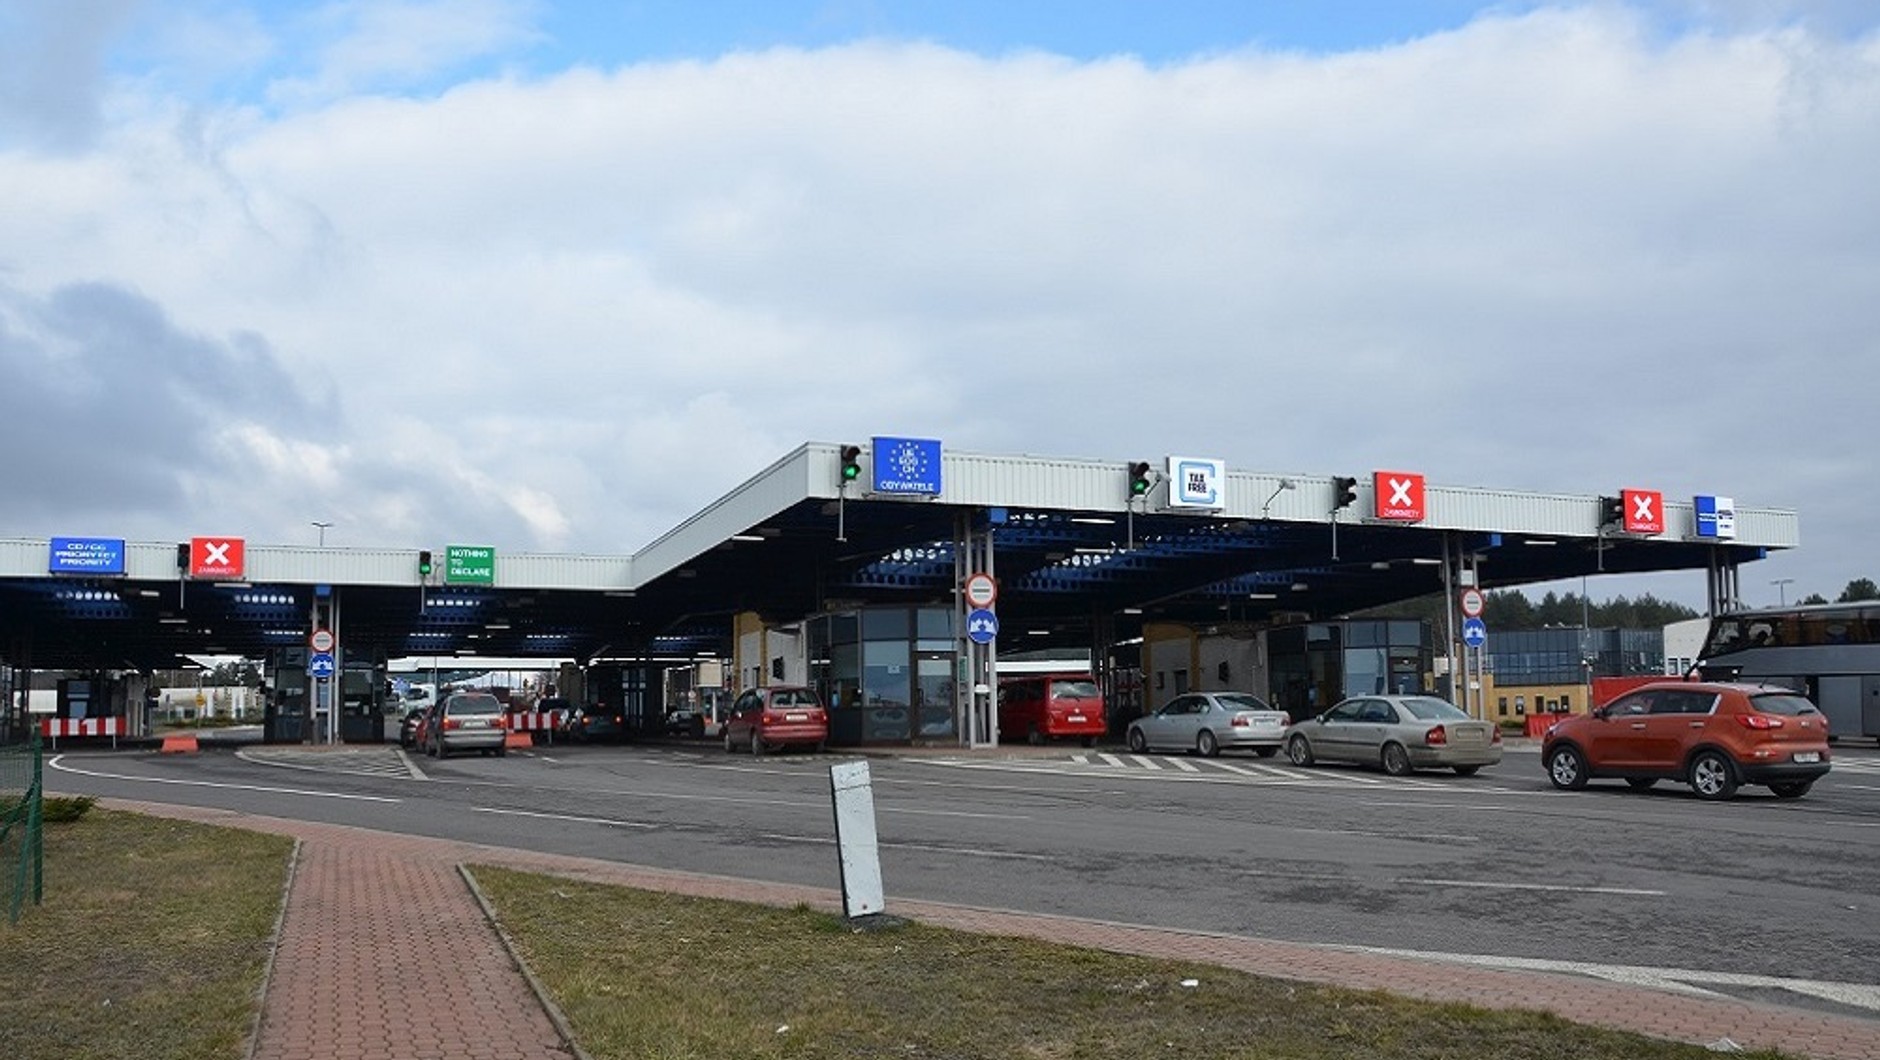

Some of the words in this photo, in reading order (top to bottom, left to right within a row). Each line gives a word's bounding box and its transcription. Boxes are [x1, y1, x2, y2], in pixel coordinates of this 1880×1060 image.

[1189, 473, 1204, 482] TAX
[1188, 482, 1207, 493] FREE
[451, 549, 489, 558] NOTHING
[60, 558, 112, 566] PRIORITY
[450, 558, 464, 567] TO
[451, 567, 491, 577] DECLARE
